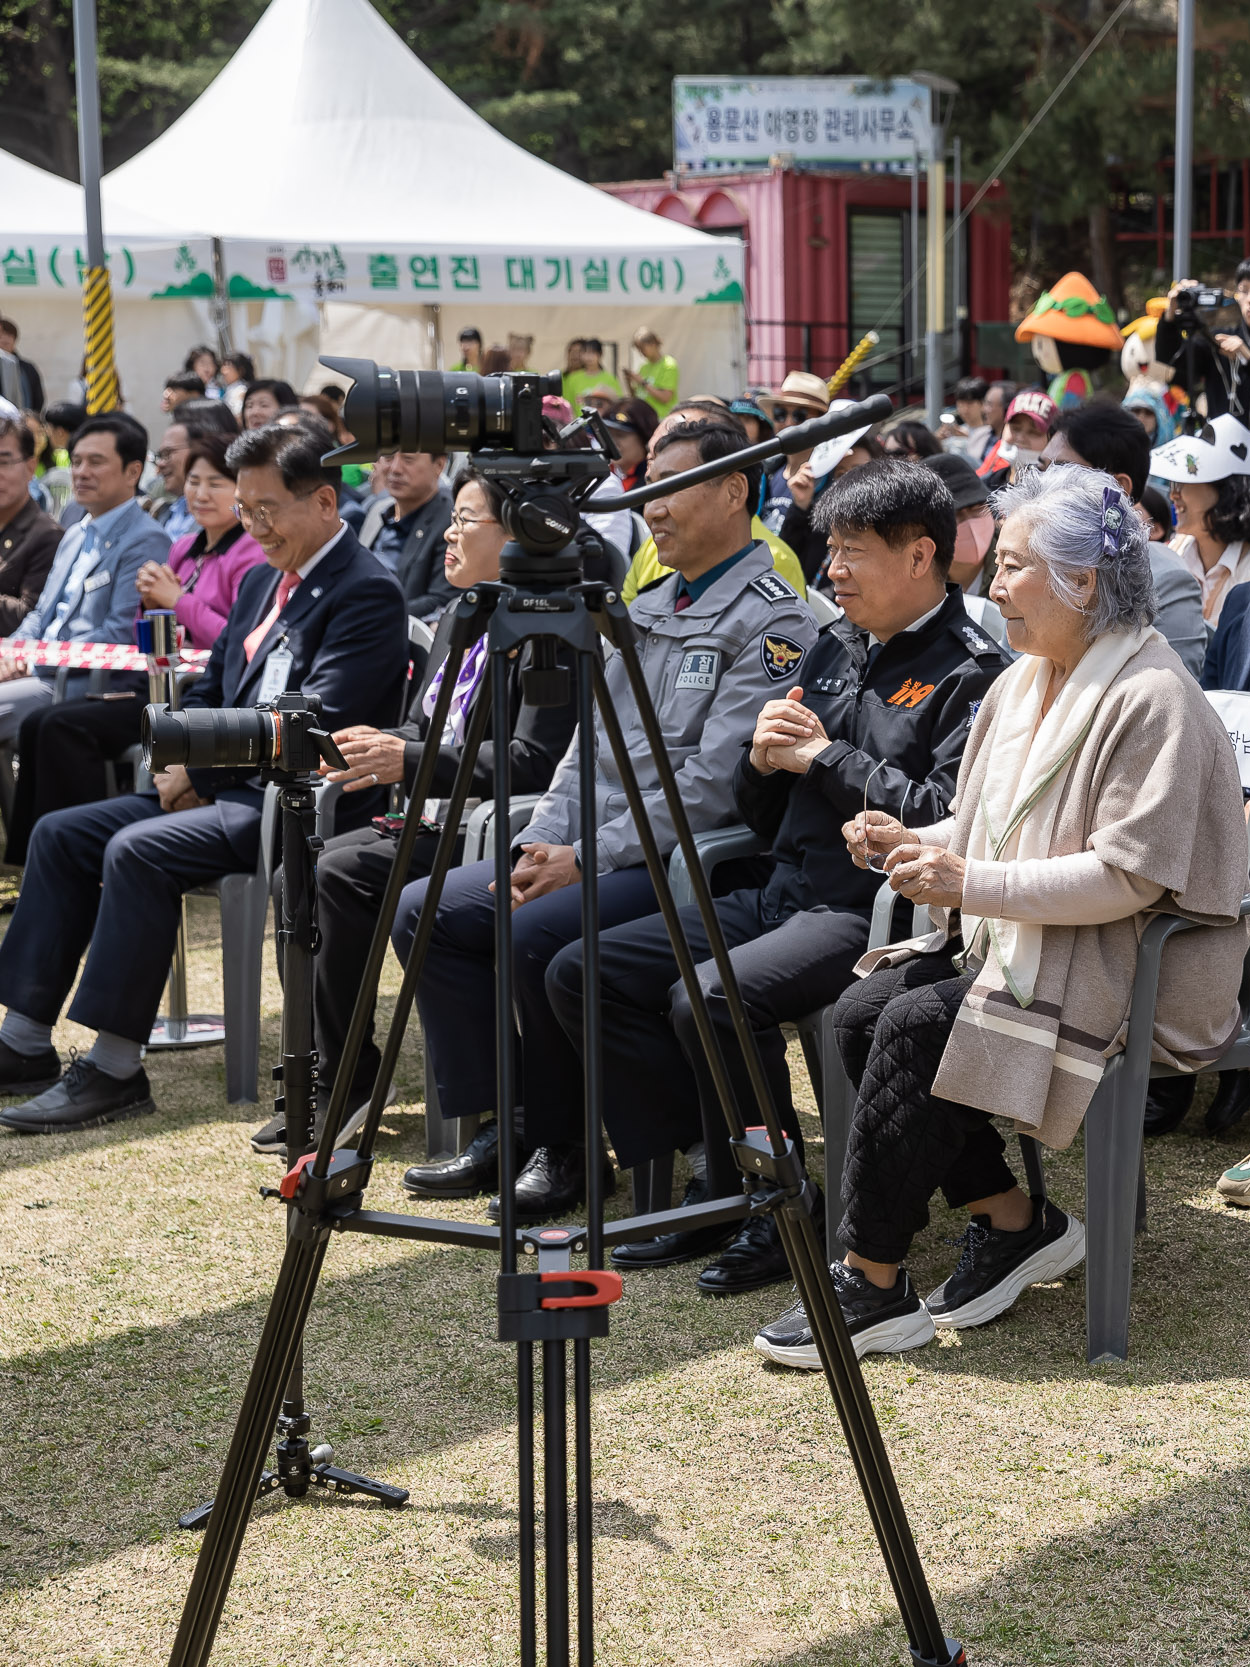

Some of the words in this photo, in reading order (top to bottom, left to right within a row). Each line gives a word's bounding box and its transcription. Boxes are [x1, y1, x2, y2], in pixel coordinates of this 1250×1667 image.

[823, 105, 915, 143] 관리사무소
[369, 254, 480, 289] 출연진
[505, 255, 685, 293] 대기실(여)
[523, 599, 550, 607] DF16L
[680, 675, 711, 685] POLICE
[887, 684, 935, 708] 119
